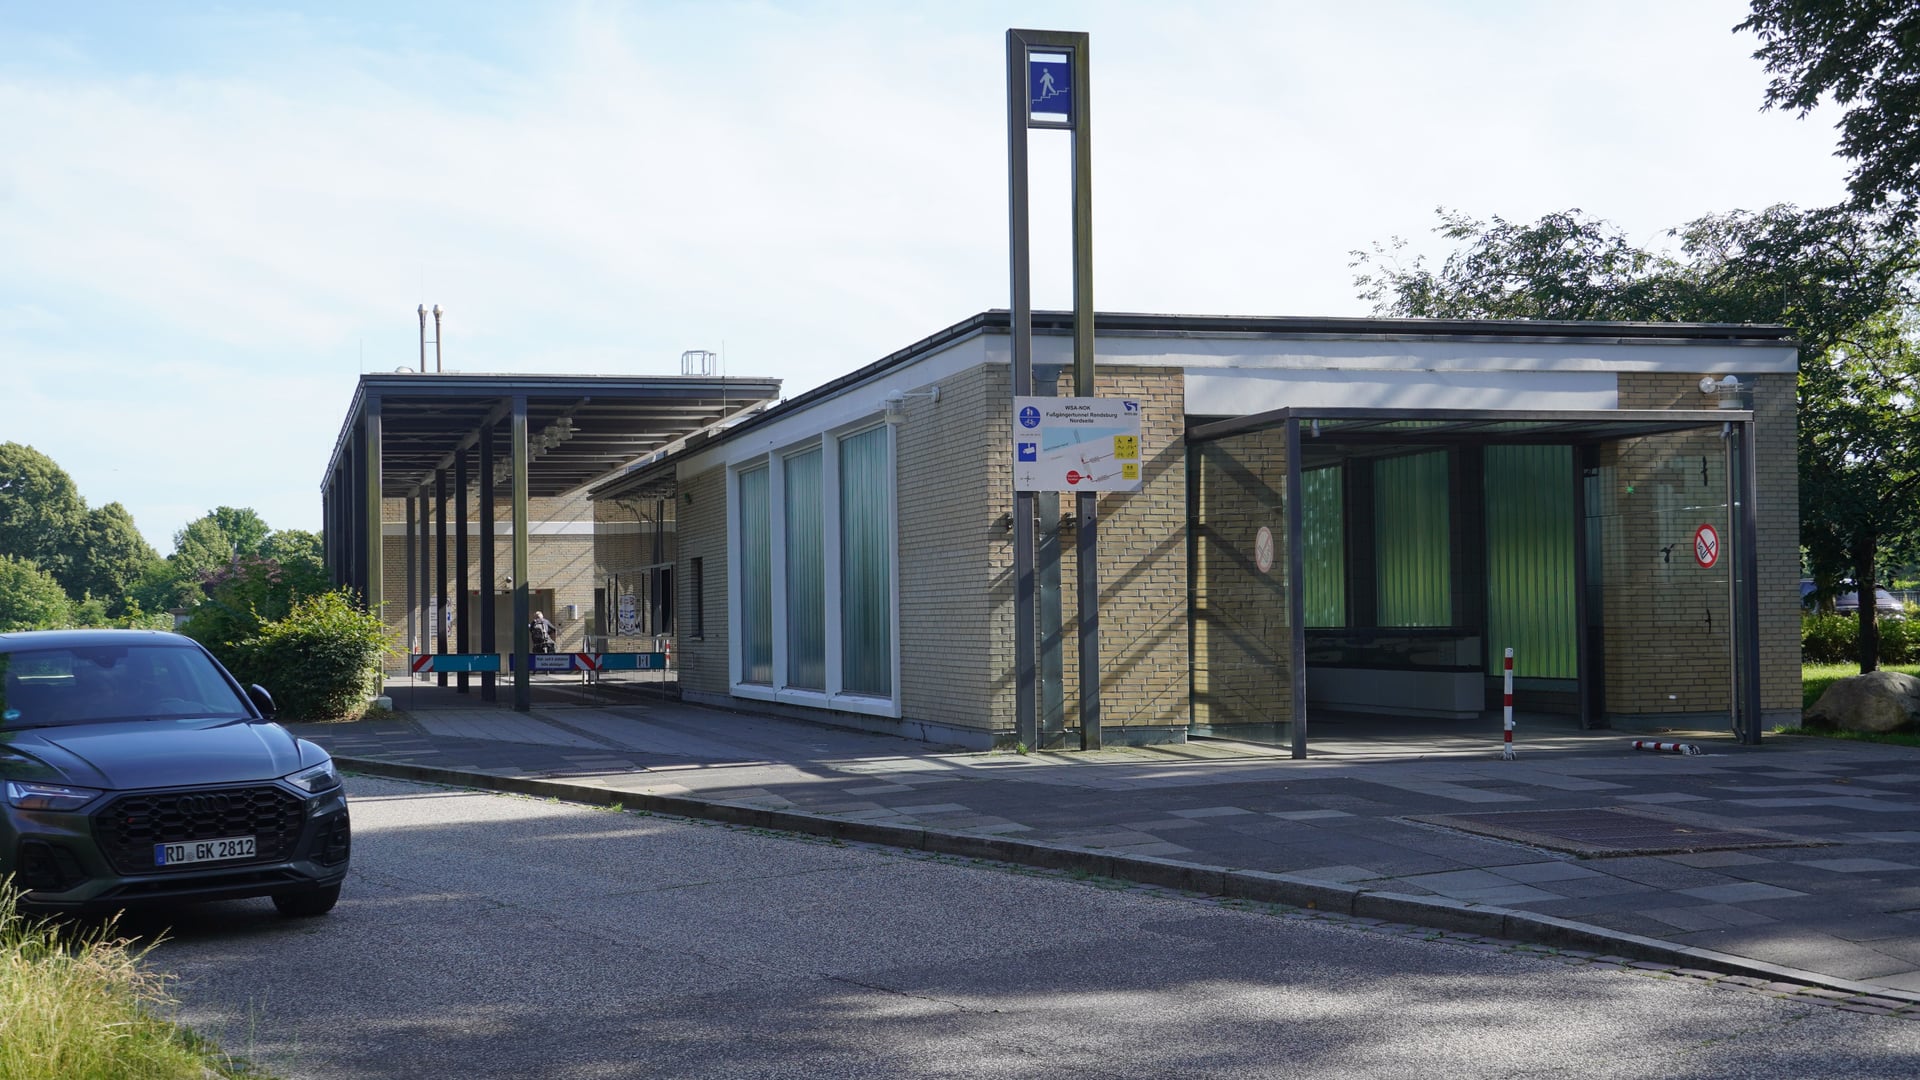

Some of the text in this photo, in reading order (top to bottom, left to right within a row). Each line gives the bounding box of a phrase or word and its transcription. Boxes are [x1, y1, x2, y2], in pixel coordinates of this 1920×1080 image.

[165, 839, 254, 863] RD GK 2812
